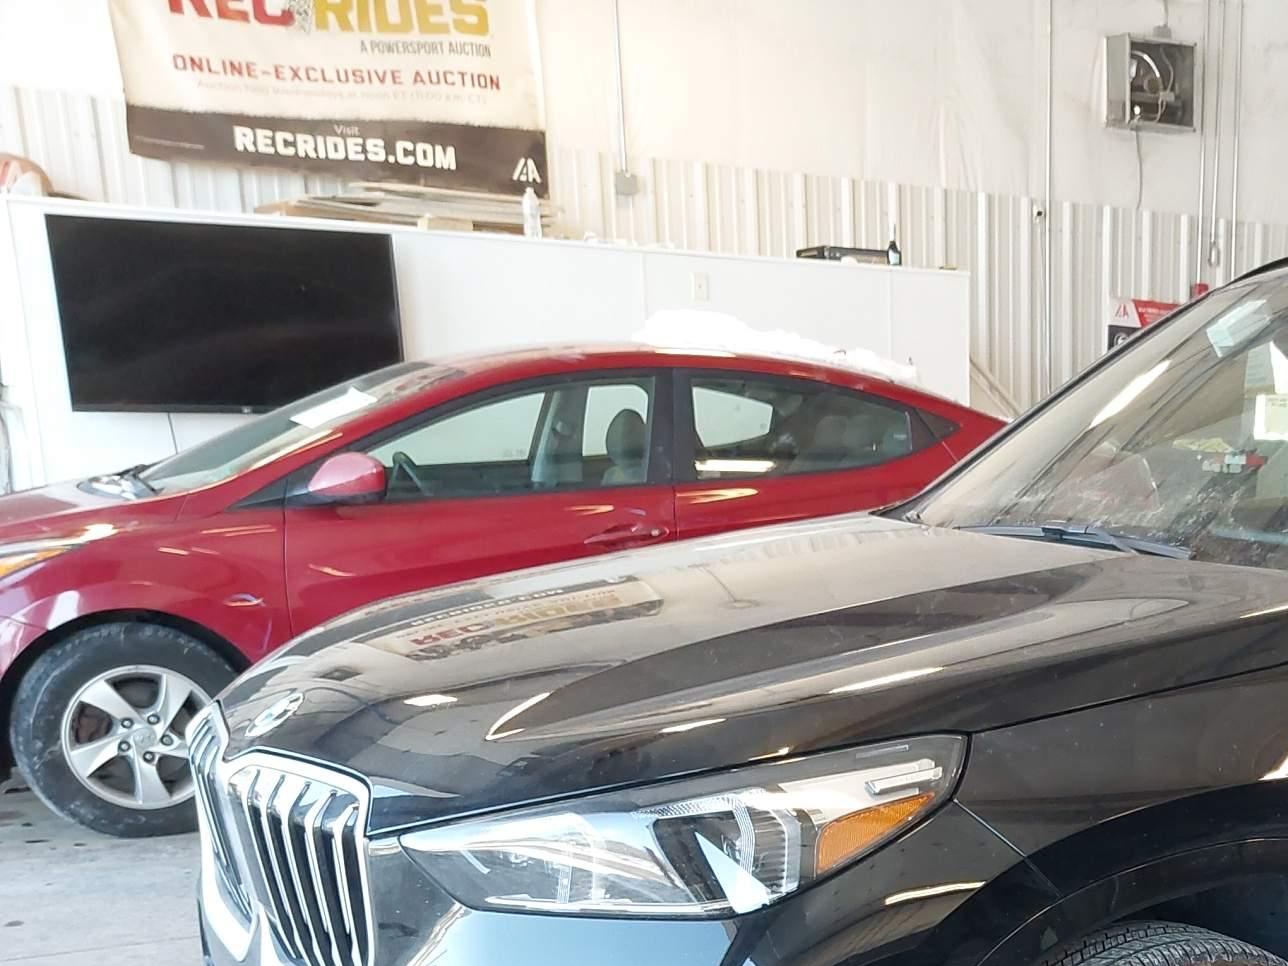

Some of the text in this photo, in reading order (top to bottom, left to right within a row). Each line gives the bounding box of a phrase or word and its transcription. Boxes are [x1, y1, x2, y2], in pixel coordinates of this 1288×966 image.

[314, 0, 490, 37] RIDES
[360, 40, 492, 58] A POWERSPORT AUCTION
[172, 53, 403, 86] ONLINE-EXCLUSIVE
[412, 70, 501, 91] AUCTION
[233, 125, 457, 171] RECRIDES.COM
[333, 124, 359, 136] Visit
